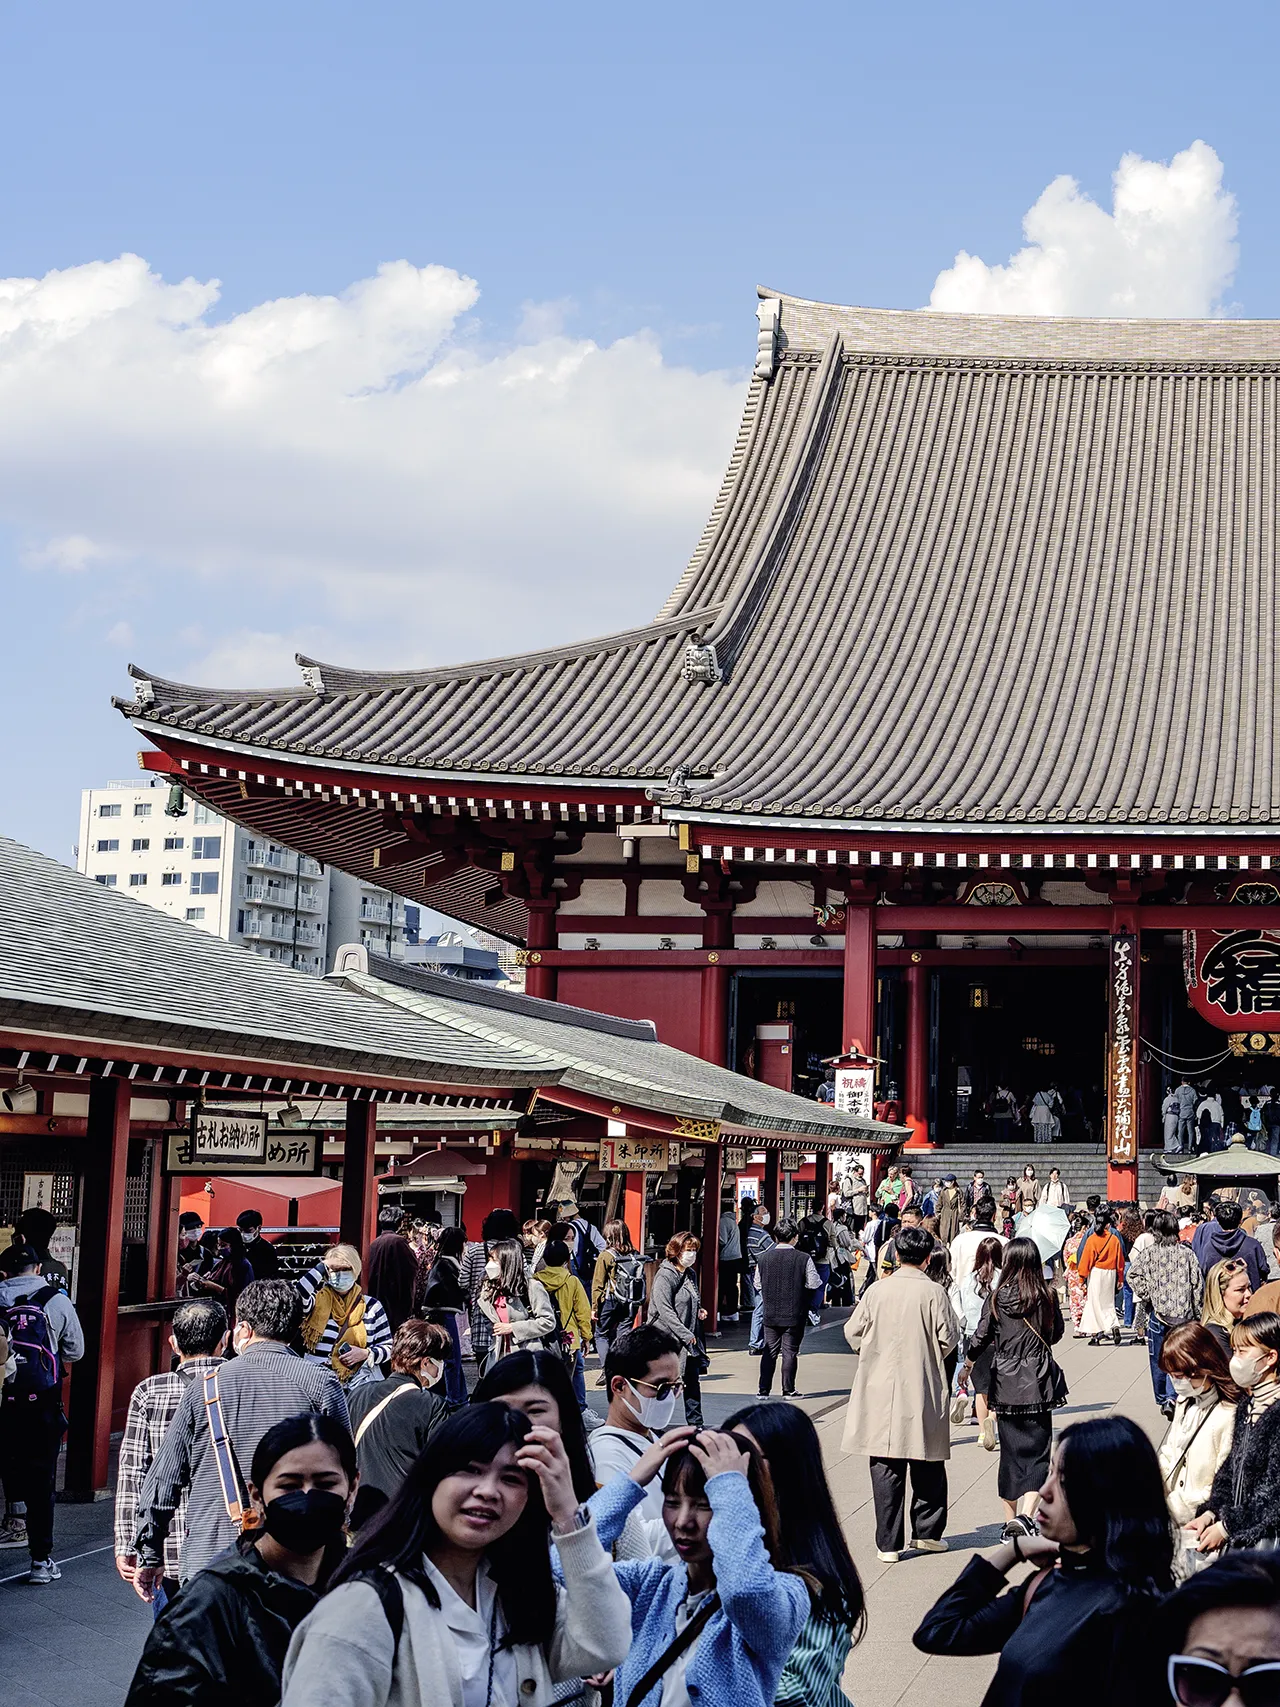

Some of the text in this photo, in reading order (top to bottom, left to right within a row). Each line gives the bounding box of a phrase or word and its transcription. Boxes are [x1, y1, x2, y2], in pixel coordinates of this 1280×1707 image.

[196, 1121, 261, 1150] 古札お納め所
[618, 1142, 665, 1160] 朱印所
